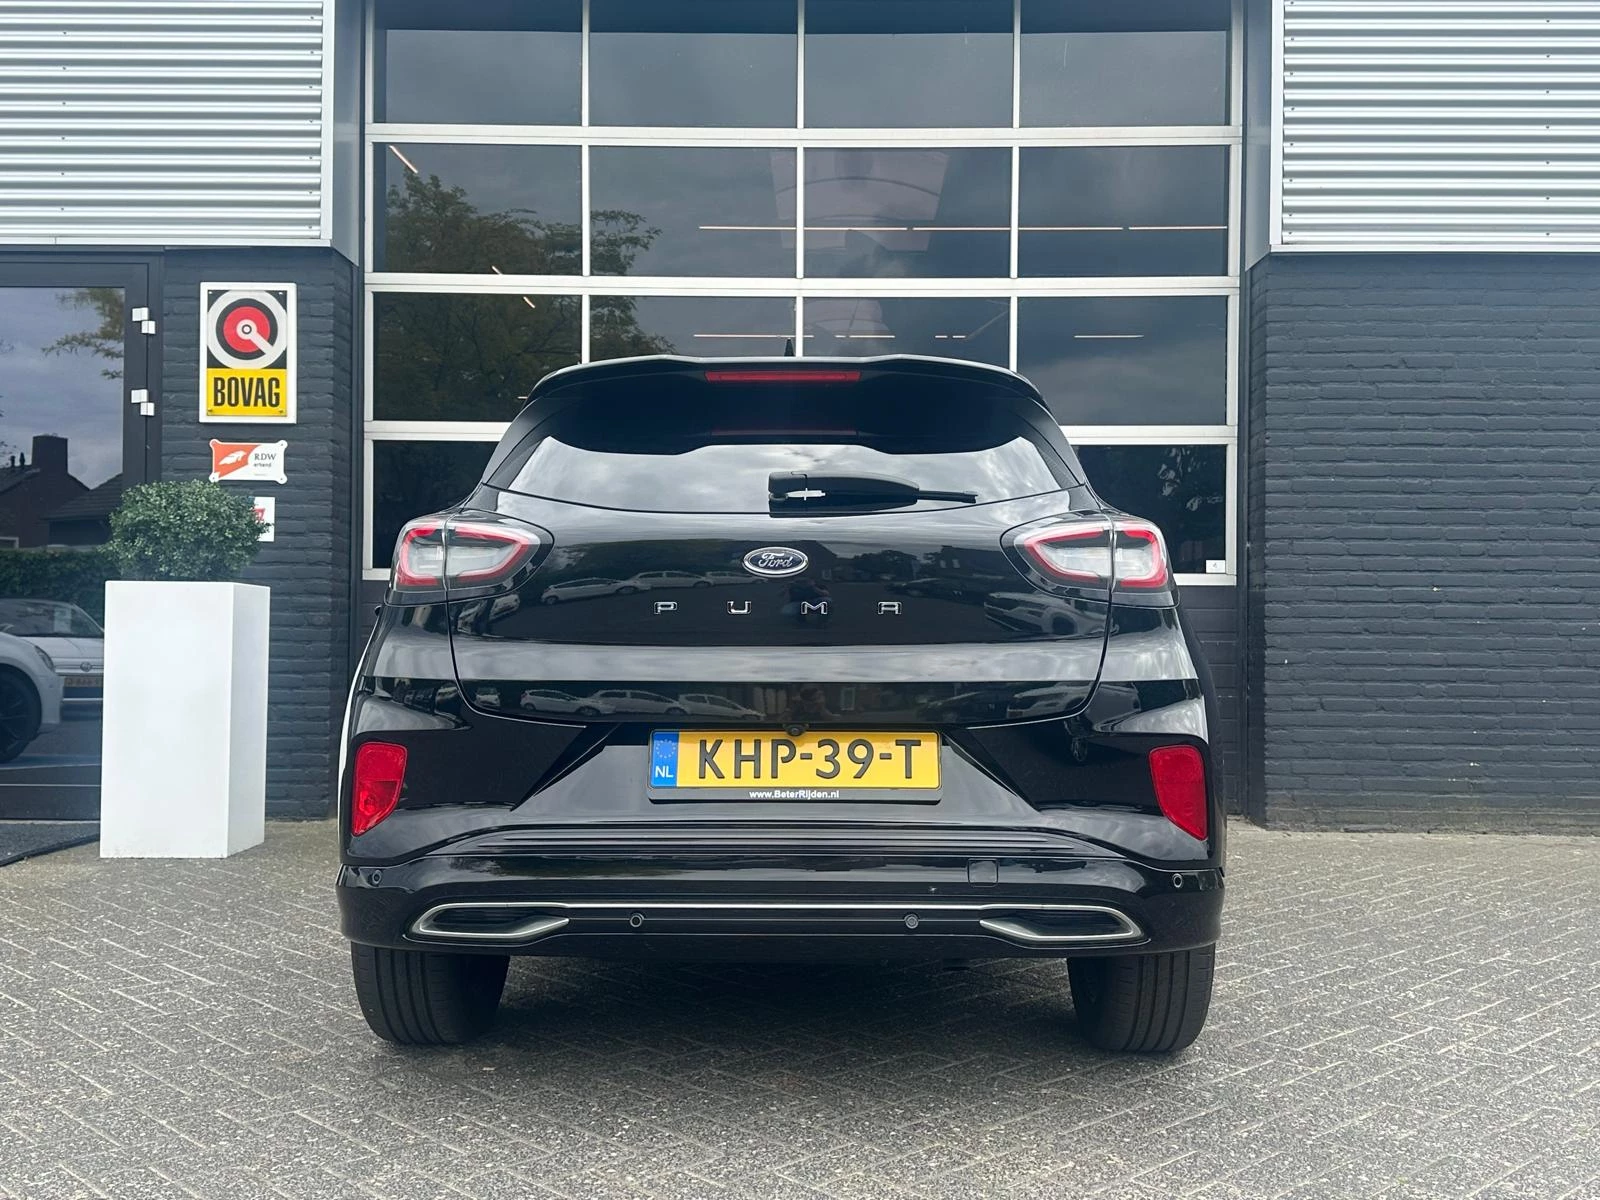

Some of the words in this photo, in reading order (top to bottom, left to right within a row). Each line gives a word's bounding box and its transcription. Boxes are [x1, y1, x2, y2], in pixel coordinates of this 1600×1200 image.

[213, 376, 280, 407] BOVAG
[254, 453, 277, 461] RDW
[758, 552, 794, 567] Ford
[653, 601, 902, 615] PUMA
[698, 738, 922, 779] KHP-39-T
[655, 766, 673, 778] NL
[749, 789, 840, 800] www.BeterRijden.nl
